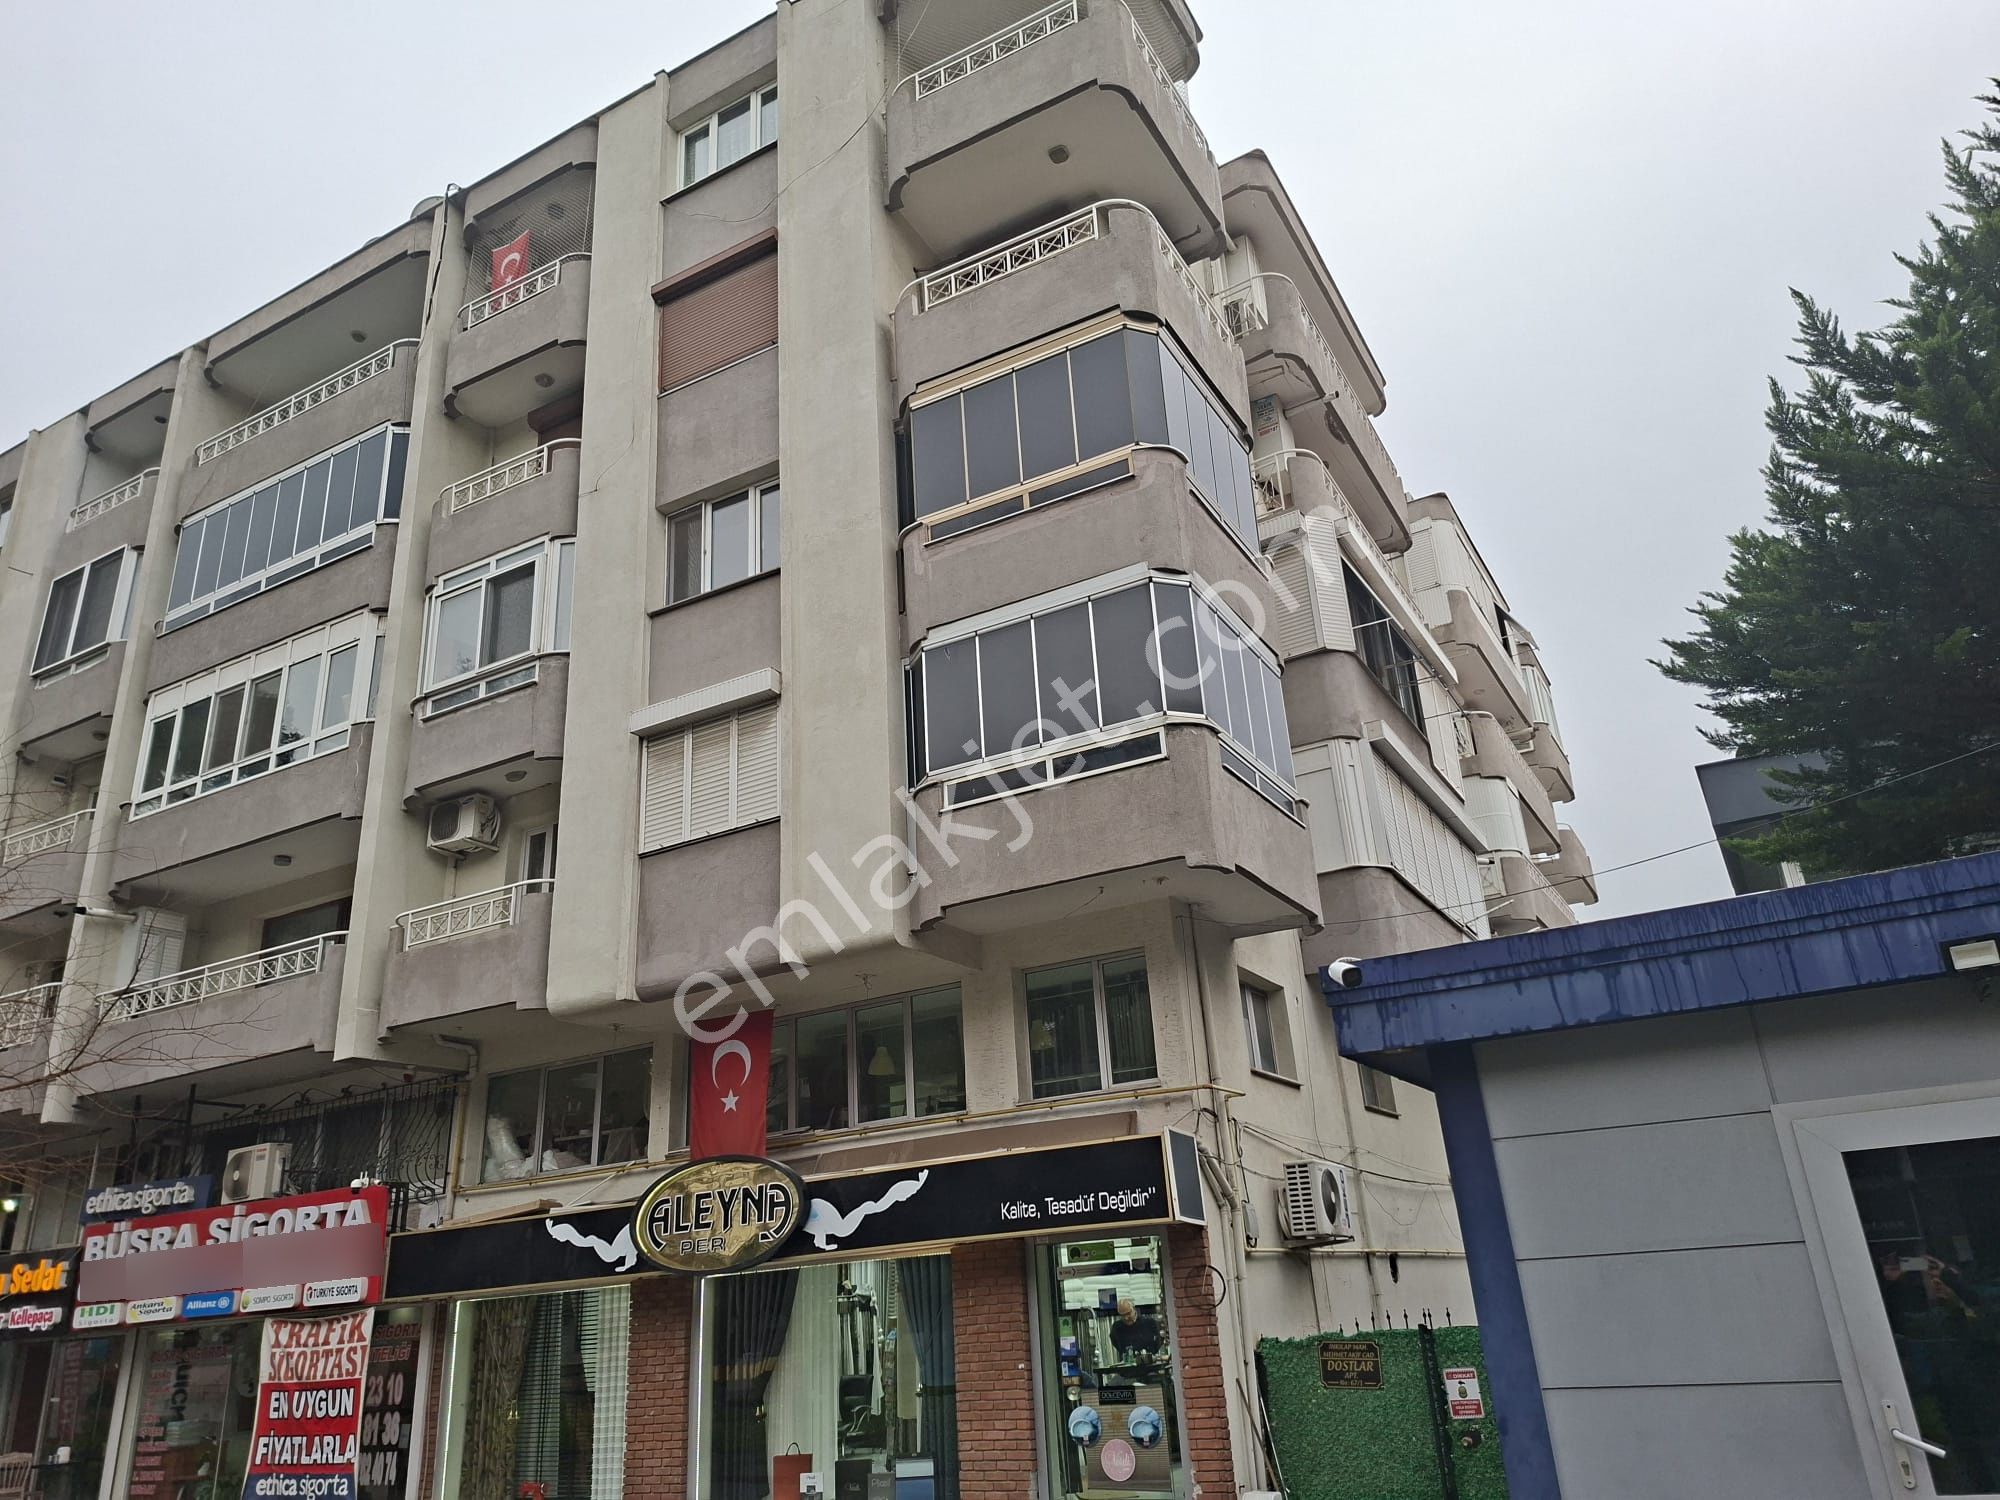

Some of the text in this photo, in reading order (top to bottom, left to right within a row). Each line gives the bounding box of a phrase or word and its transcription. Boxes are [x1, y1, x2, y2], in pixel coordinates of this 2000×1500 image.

[647, 1182, 793, 1250] ALEYNA
[1000, 1201, 1041, 1221] Kalite,
[1044, 1194, 1095, 1216] Tesadüf
[680, 1236, 726, 1256] PER
[10, 1258, 66, 1295] Sedat
[80, 1305, 116, 1318] HDI
[130, 1300, 164, 1311] Ankara
[139, 1306, 173, 1317] Sigorta
[187, 1298, 217, 1310] Allianz
[1327, 1360, 1374, 1371] DOSTLAR
[269, 1388, 354, 1419] EN UYGUN
[255, 1429, 358, 1466] FİYATLARLA
[256, 1473, 349, 1500] ethica sigorta
